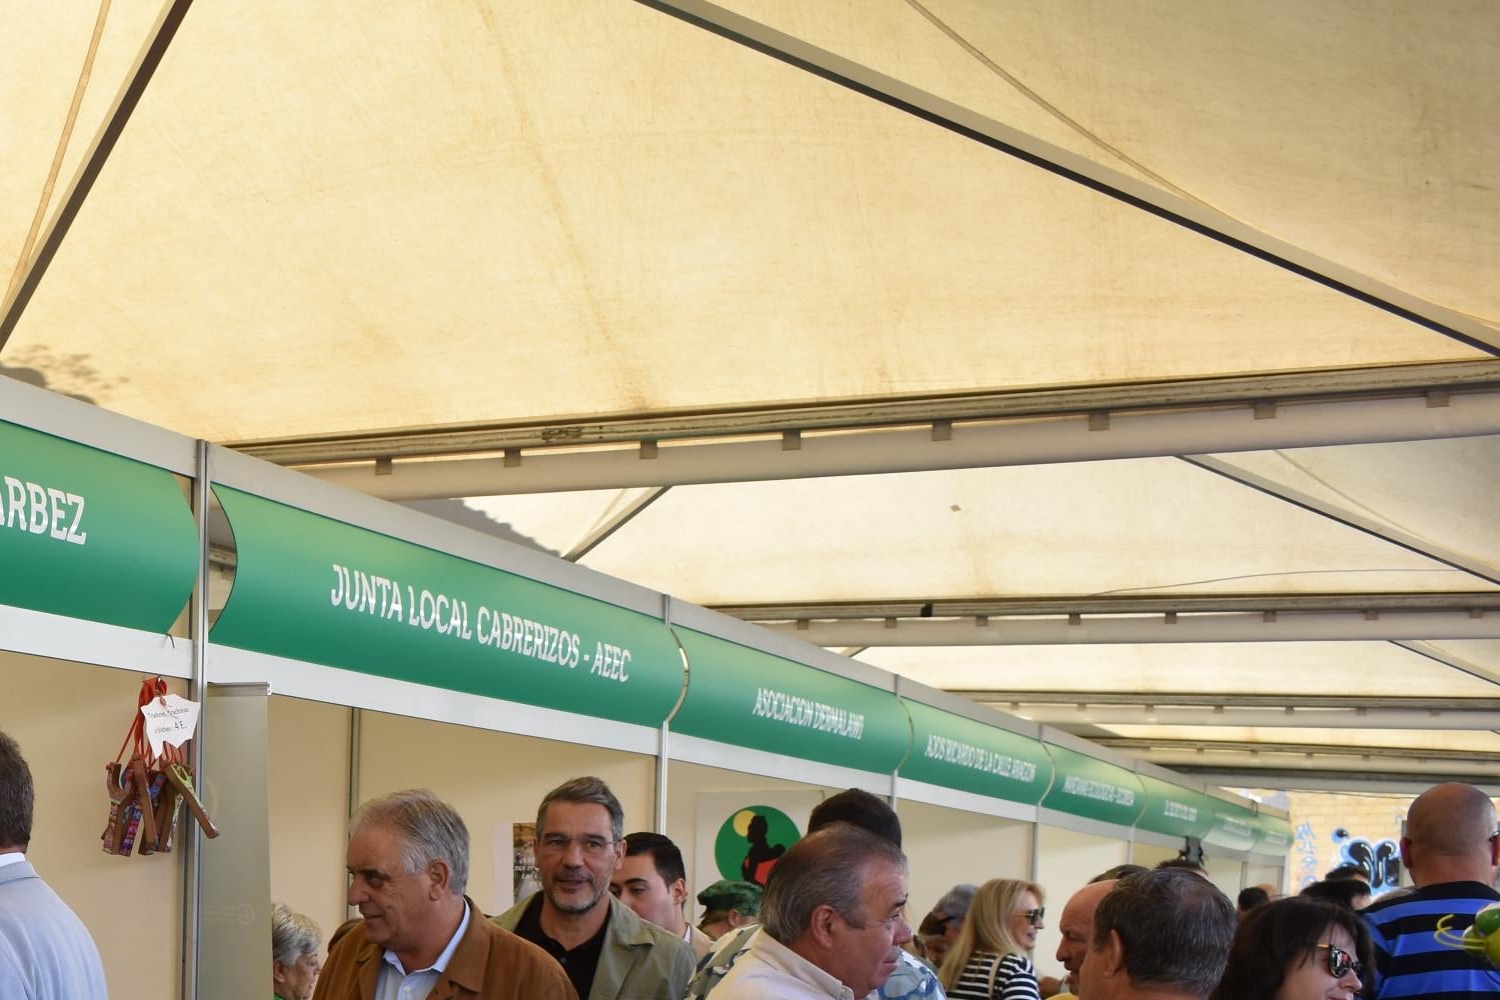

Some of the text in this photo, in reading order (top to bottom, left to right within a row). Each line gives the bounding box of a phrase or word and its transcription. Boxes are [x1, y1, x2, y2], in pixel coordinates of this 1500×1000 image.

[330, 563, 403, 623] JUNTA
[407, 585, 473, 640] LOCAL
[476, 606, 581, 670] CABRERIZOS
[590, 640, 632, 684] AEEC
[752, 687, 814, 728] ASOCIACION
